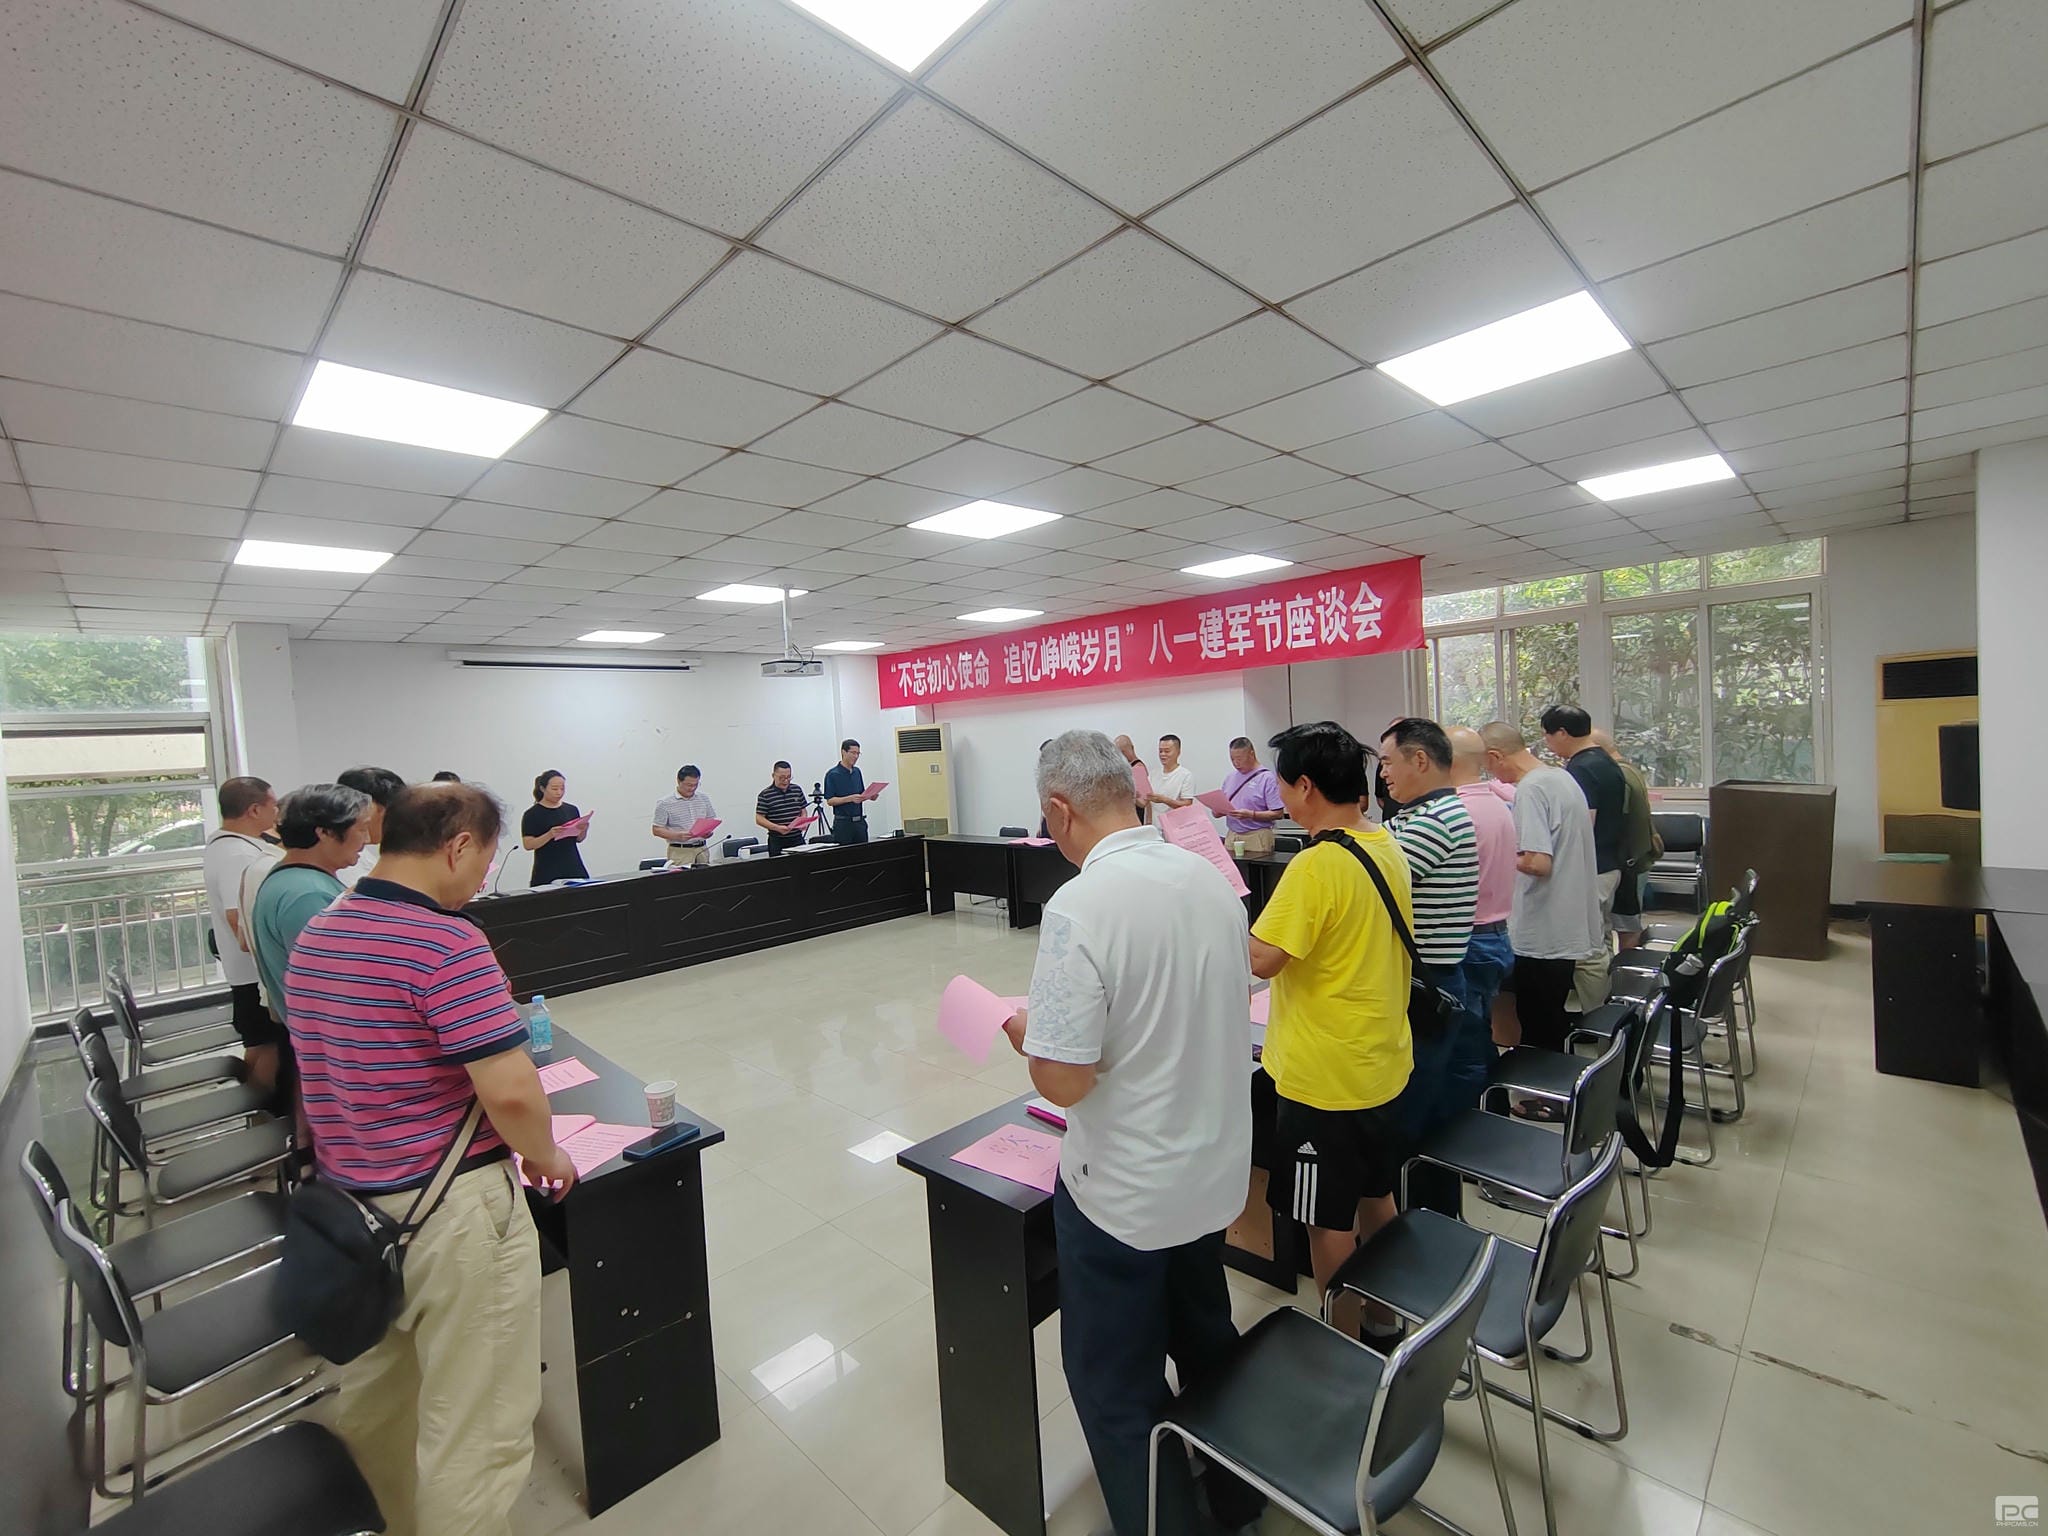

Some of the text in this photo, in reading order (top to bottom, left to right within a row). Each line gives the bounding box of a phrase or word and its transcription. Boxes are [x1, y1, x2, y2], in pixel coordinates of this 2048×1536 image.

[891, 581, 1383, 698] “不忘初心使命 追忆峥嵘岁月” 八一建军节座谈会
